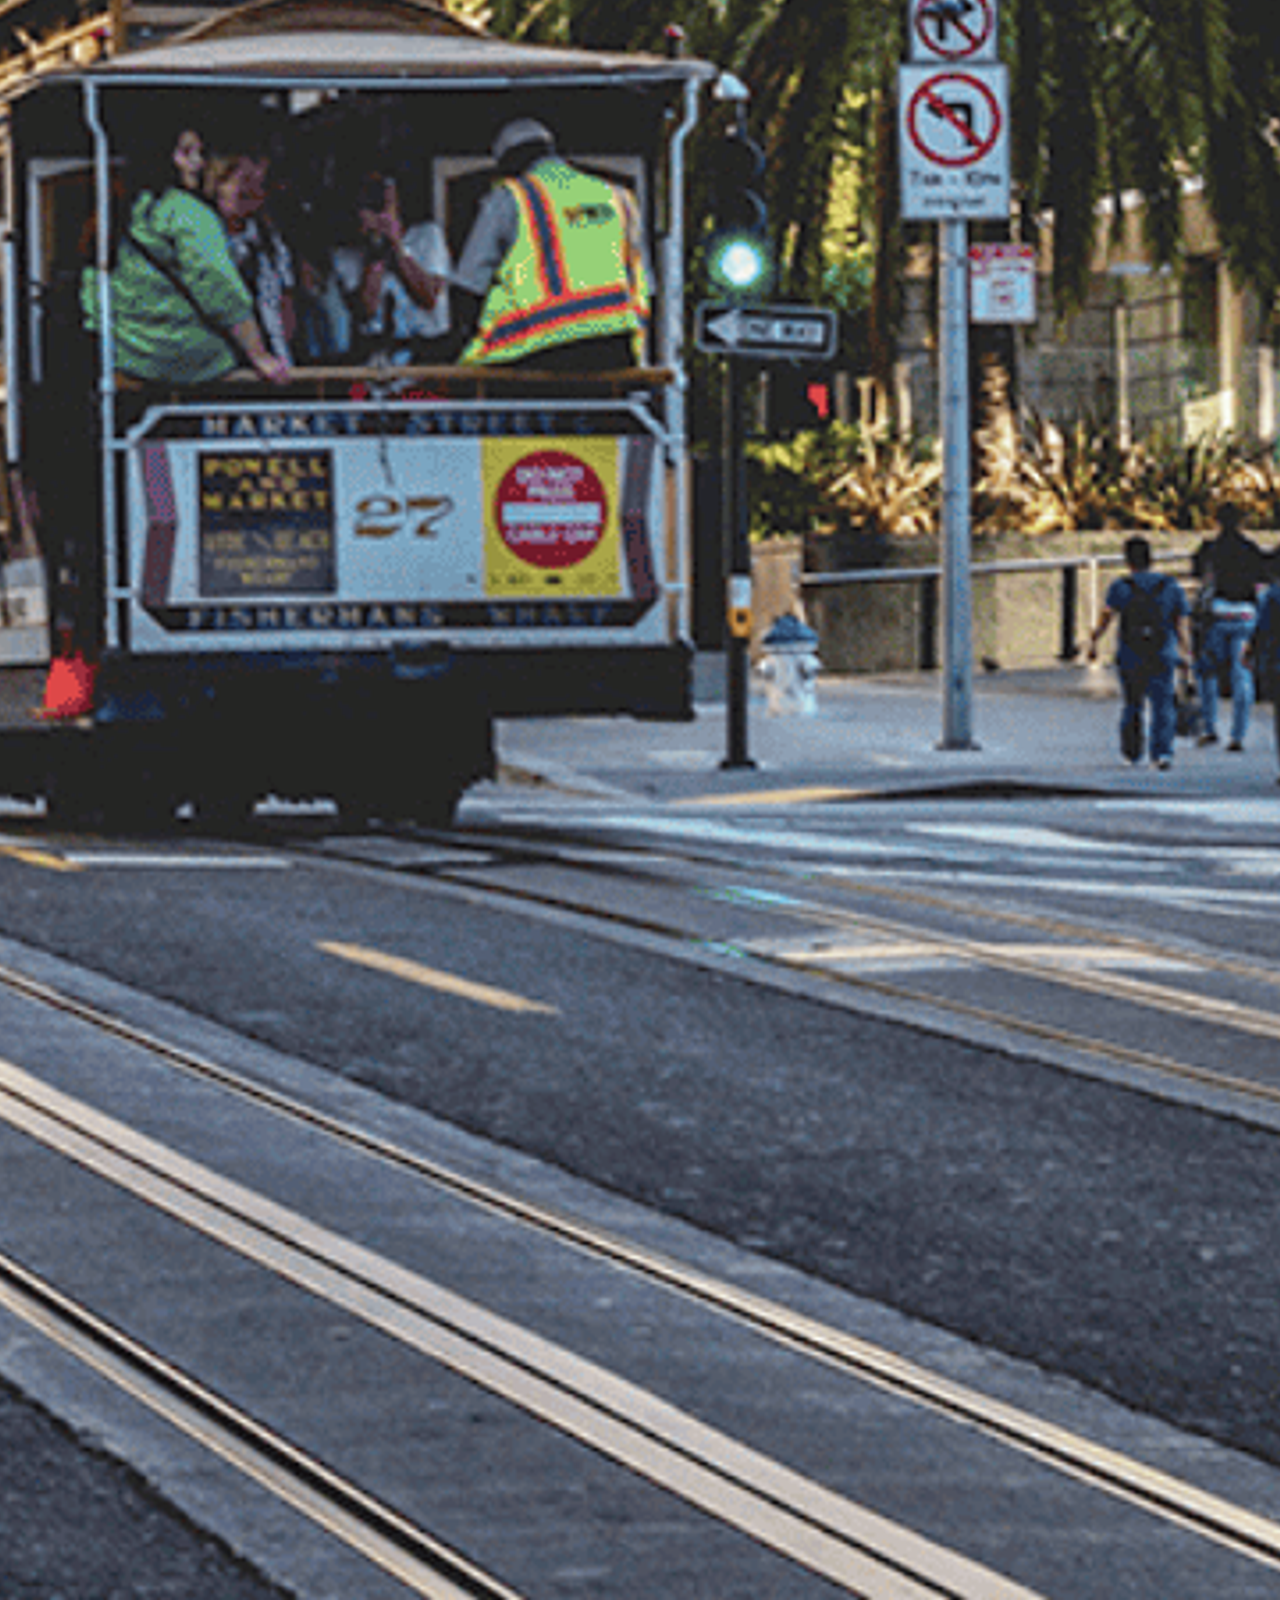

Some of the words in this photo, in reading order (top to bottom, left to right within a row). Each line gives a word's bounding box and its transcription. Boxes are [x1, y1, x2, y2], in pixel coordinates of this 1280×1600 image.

[203, 412, 362, 437] MARKET
[202, 457, 328, 477] POWELL
[239, 475, 298, 492] AND
[202, 490, 328, 511] MARKET
[353, 494, 456, 539] 27
[187, 604, 444, 629] FISHERMANS
[488, 604, 611, 629] WHARF
